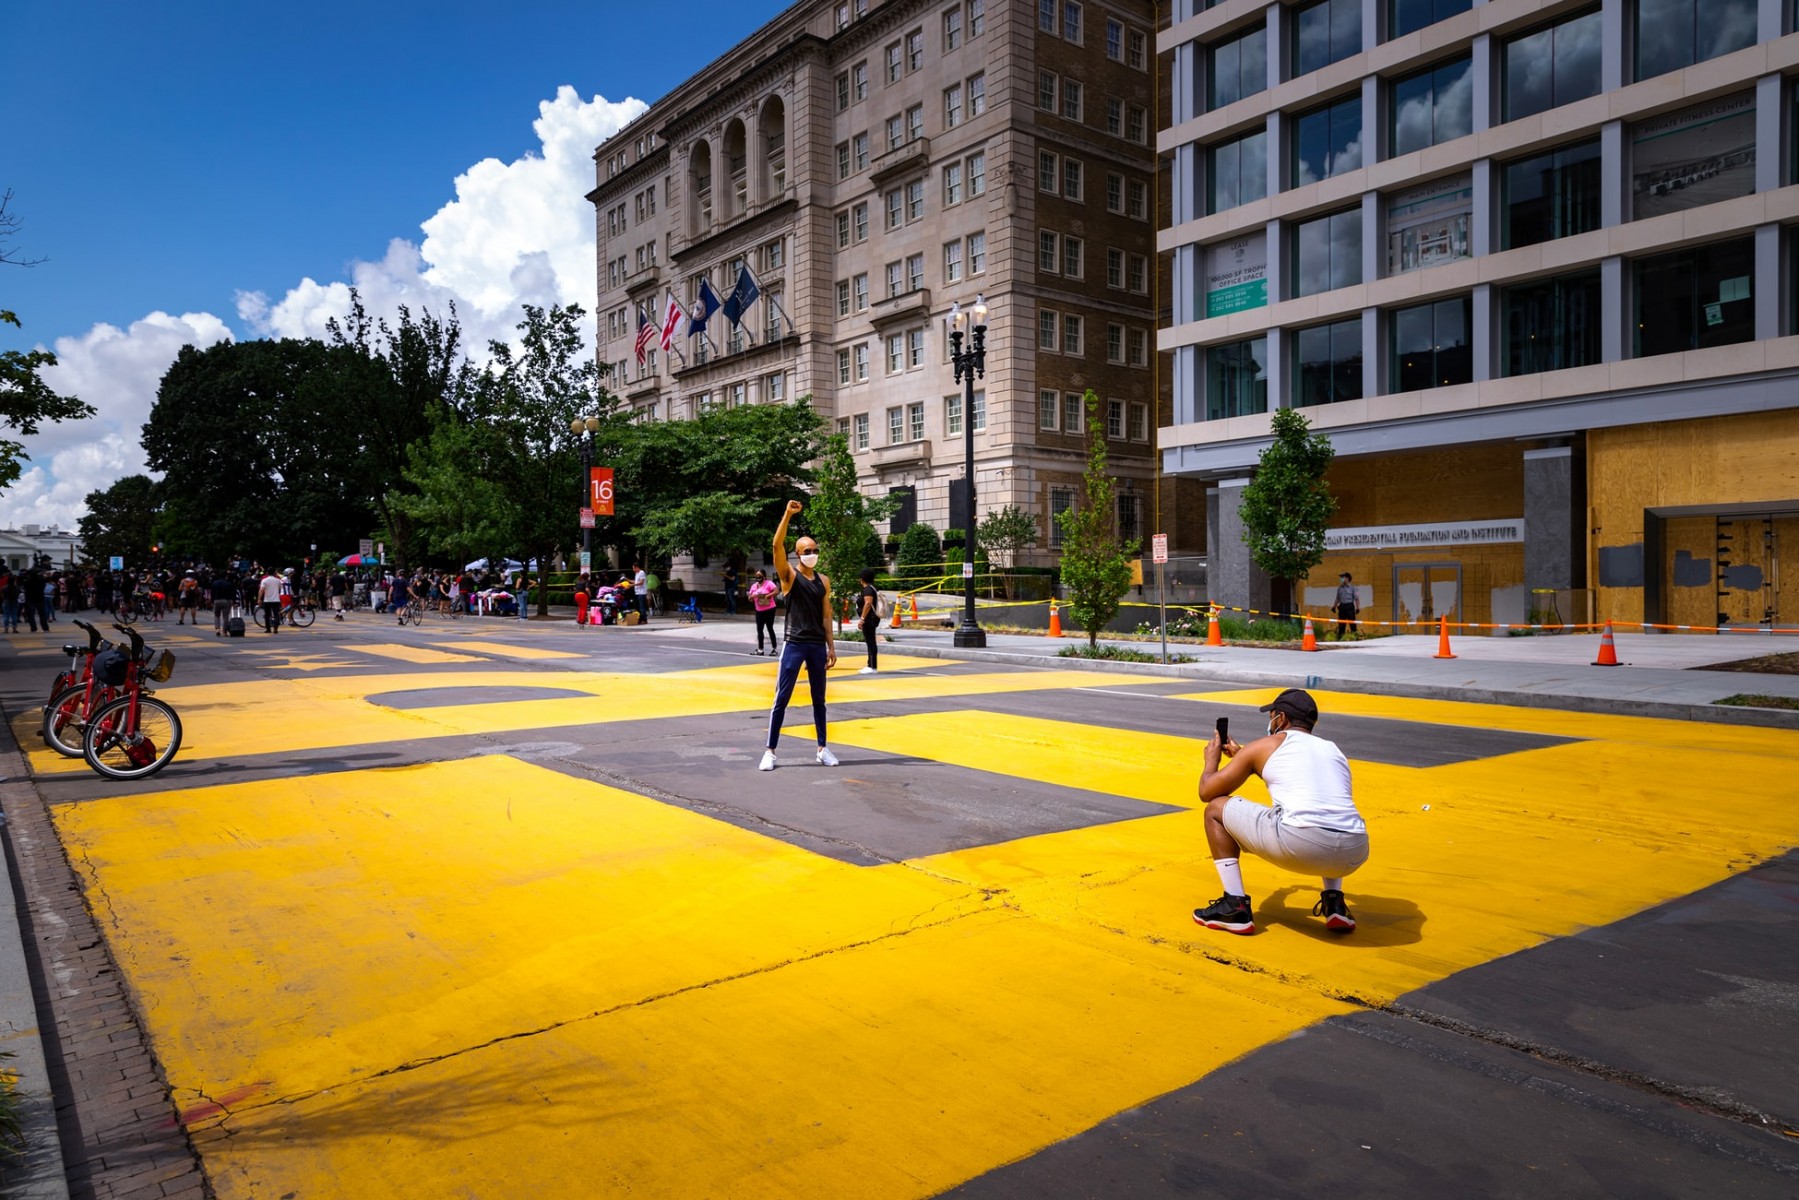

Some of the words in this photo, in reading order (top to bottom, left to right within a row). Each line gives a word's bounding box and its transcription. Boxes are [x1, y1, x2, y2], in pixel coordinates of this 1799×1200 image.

[1644, 119, 1677, 133] PRIVATE
[1680, 108, 1714, 124] FITNESS
[1716, 98, 1751, 114] CENTER
[1231, 241, 1248, 250] LEASE
[1244, 265, 1266, 273] TROPH
[1219, 278, 1240, 287] OFFICE
[1244, 272, 1263, 281] SPACE
[1344, 532, 1397, 544] PRESIDENTIAL
[1400, 529, 1450, 542] FOUNDATION
[1452, 528, 1470, 540] AND
[1472, 526, 1517, 539] INSTITUTE
